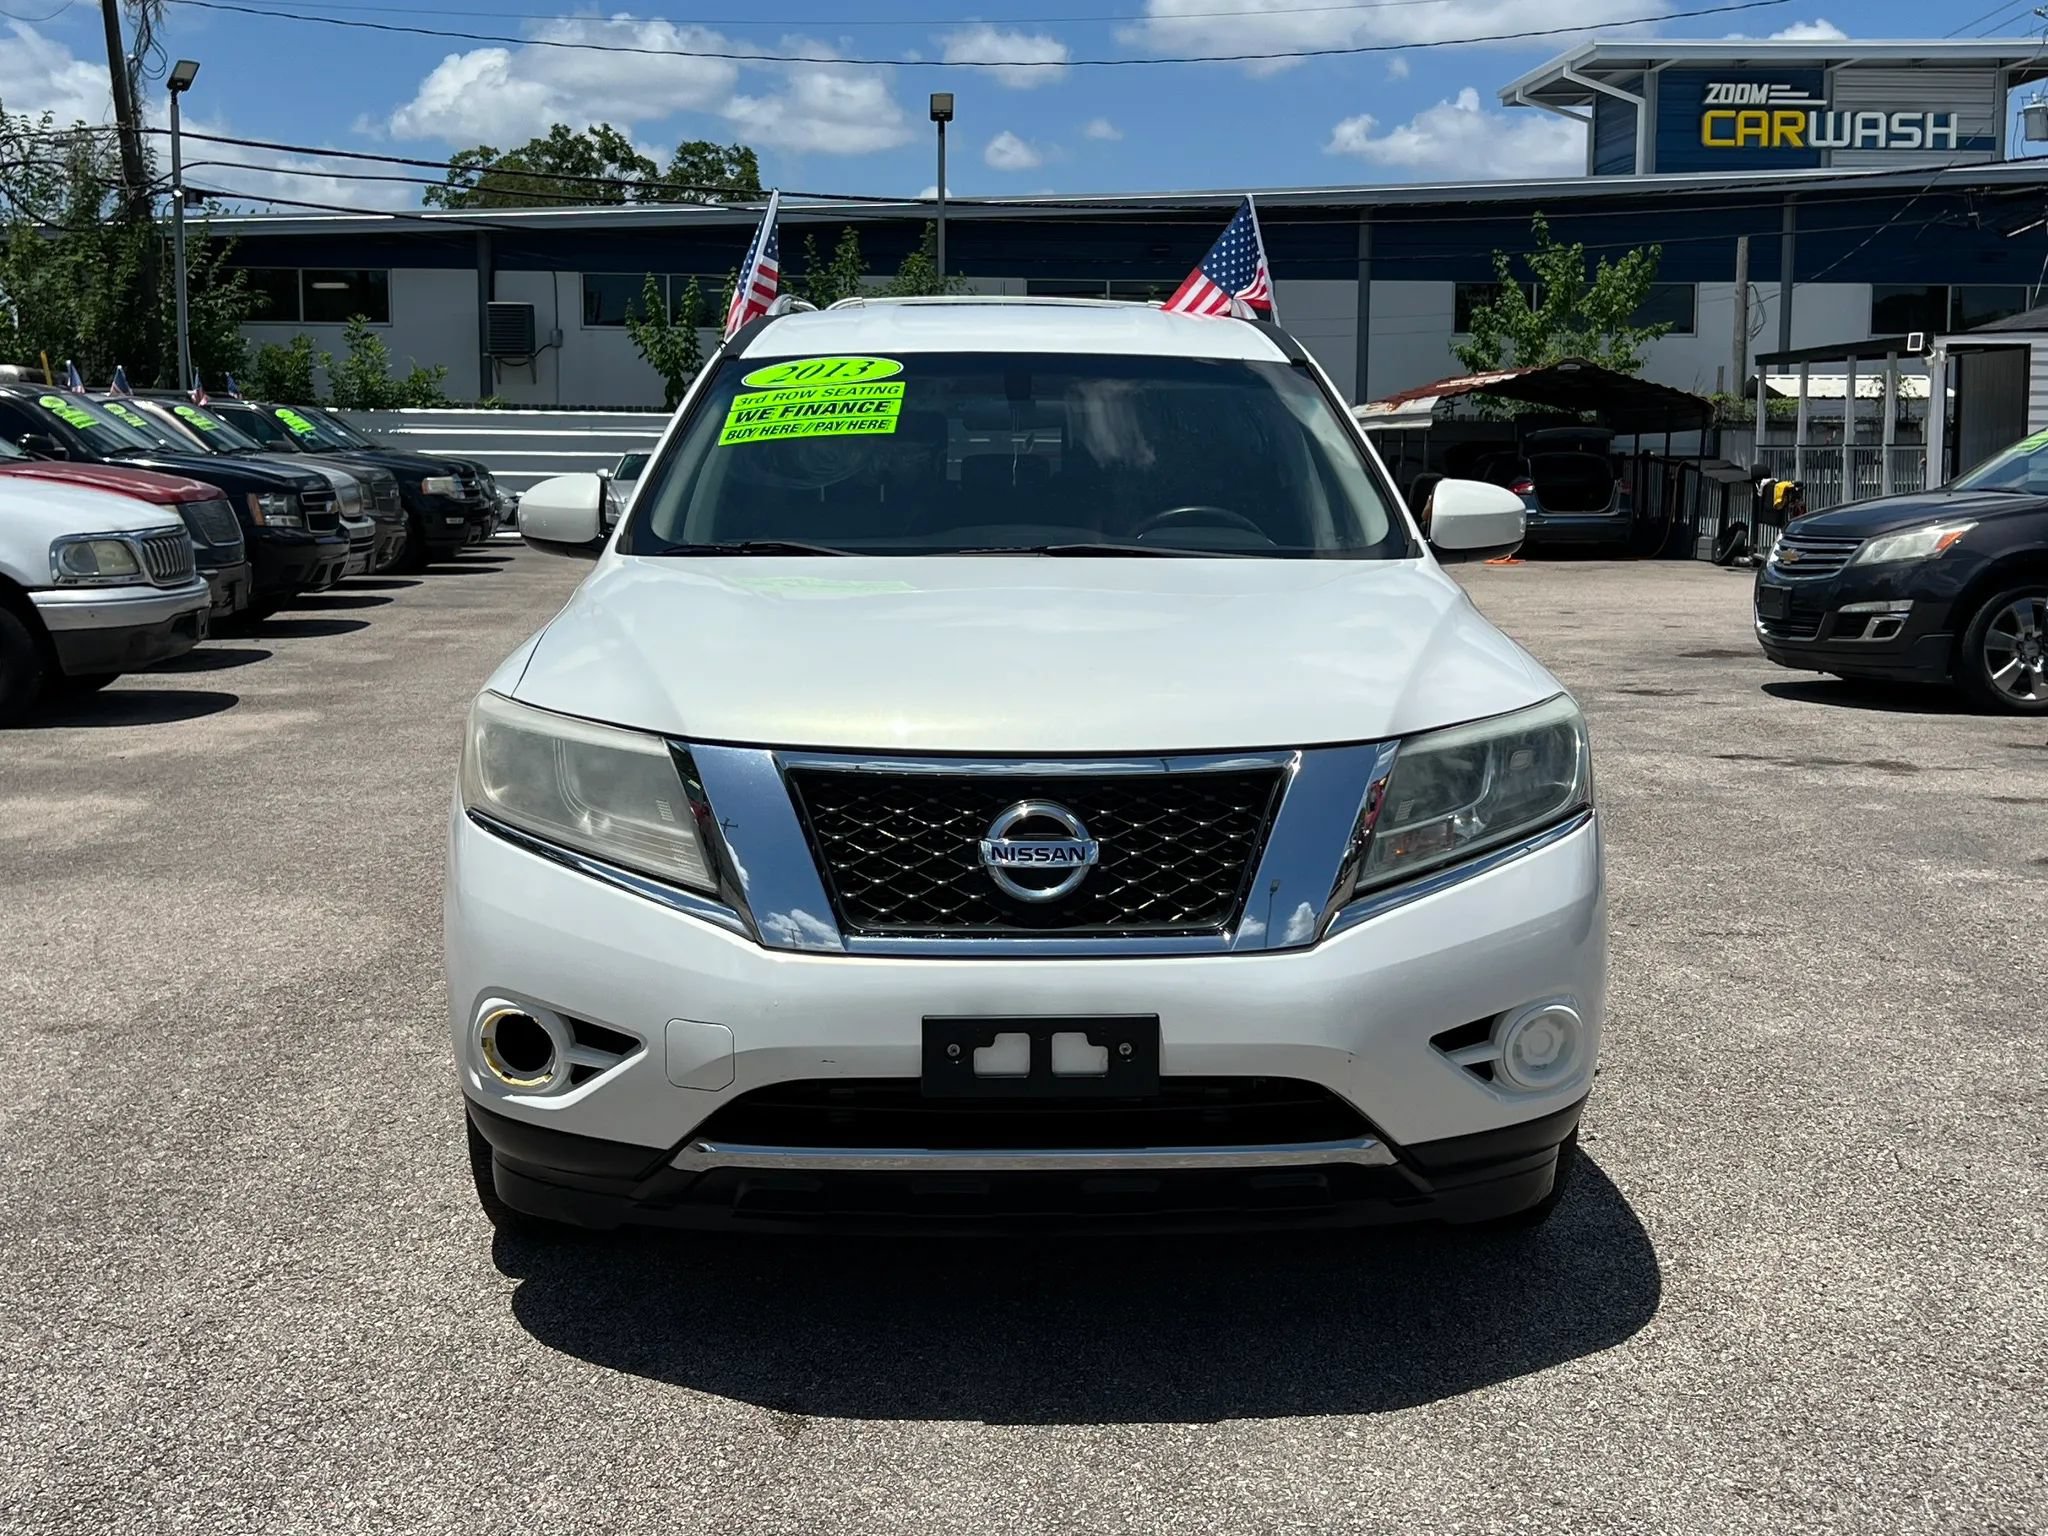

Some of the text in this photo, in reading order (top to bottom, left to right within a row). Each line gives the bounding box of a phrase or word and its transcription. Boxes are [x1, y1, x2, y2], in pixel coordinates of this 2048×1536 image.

[1704, 83, 1769, 105] ZOOM
[768, 360, 875, 384] 2013
[735, 385, 900, 406] 3rd ROW SEATING
[735, 400, 892, 424] WE FINANCE
[725, 428, 757, 441] BUY
[759, 423, 799, 436] HERE
[846, 418, 888, 431] HERE
[991, 846, 1086, 862] NISSAN
